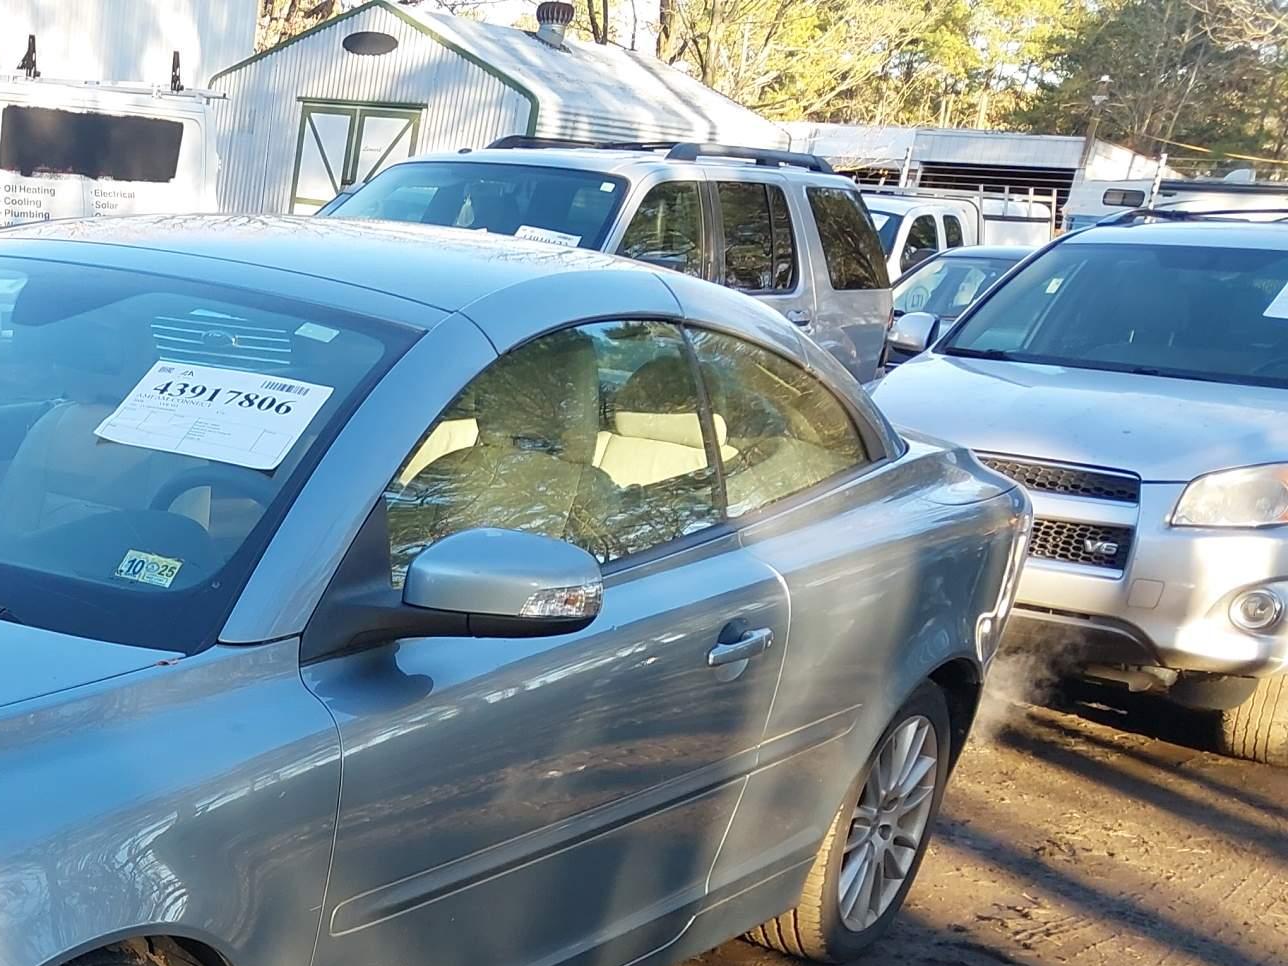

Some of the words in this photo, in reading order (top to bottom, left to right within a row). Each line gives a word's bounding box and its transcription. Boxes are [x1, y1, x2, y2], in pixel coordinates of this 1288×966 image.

[3, 184, 17, 193] Oil
[19, 184, 56, 197] Heating
[94, 189, 136, 199] Electrical
[3, 196, 42, 208] Cooling
[95, 200, 119, 209] Solar
[4, 209, 50, 220] Plumbing
[153, 380, 297, 415] 43917806
[1084, 540, 1118, 555] V6
[126, 558, 145, 575] 10
[158, 564, 177, 577] 25
